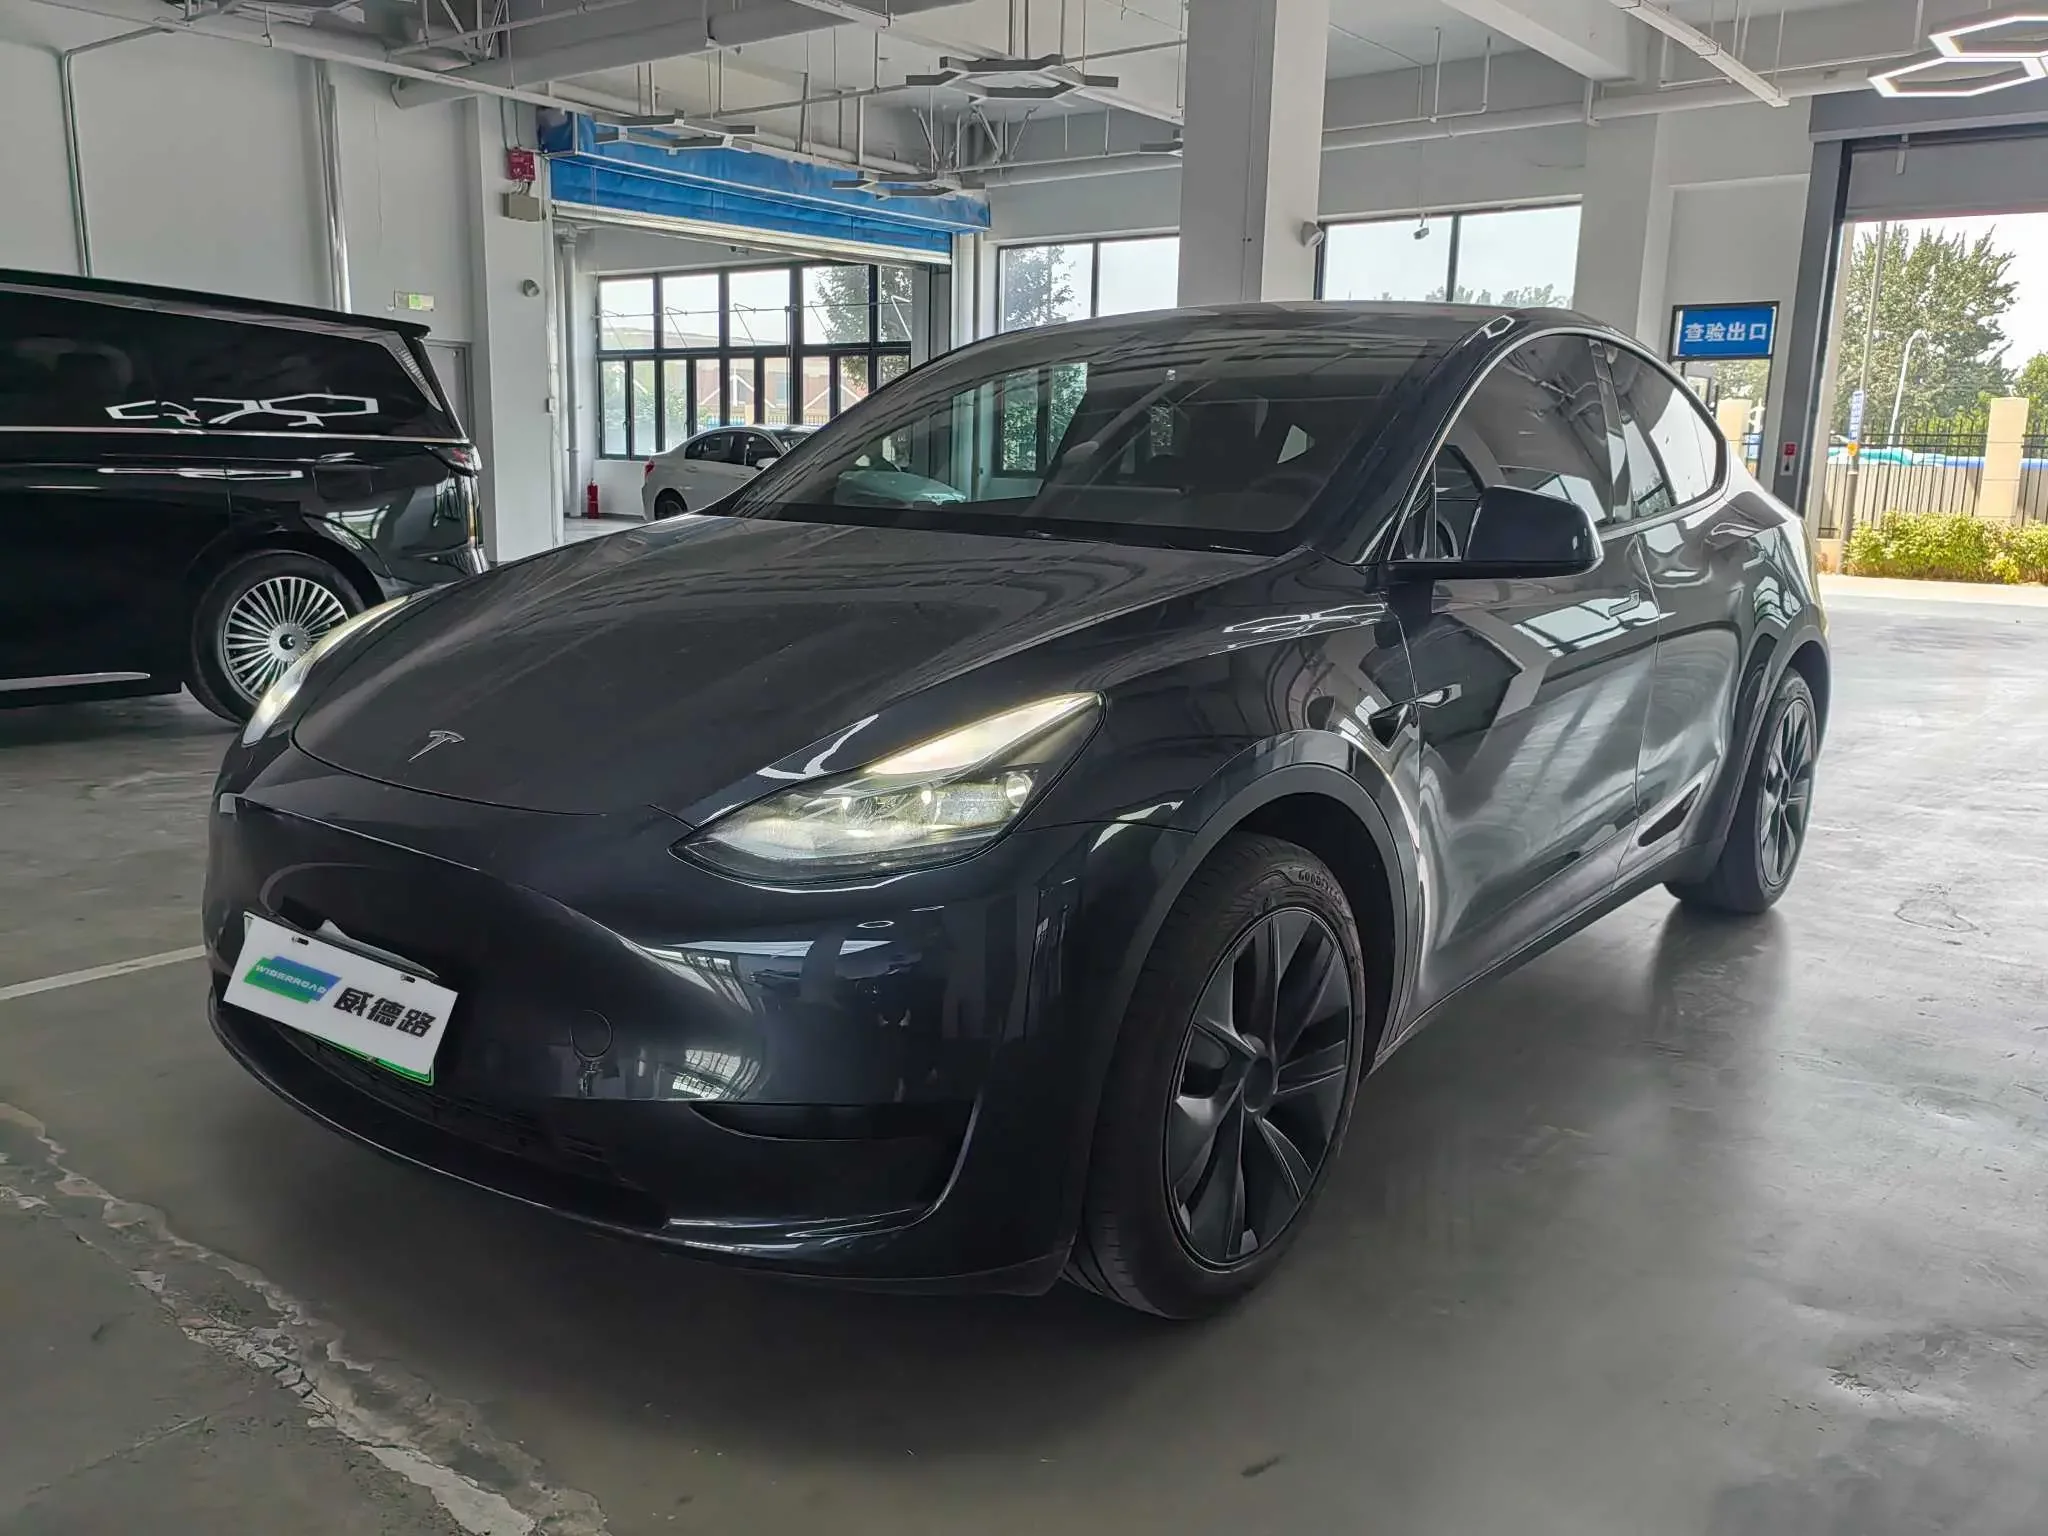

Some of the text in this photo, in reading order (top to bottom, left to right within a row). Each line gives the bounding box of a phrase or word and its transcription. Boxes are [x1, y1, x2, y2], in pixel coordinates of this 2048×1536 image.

[1684, 321, 1767, 342] 查验出口
[333, 987, 436, 1038] 威德路
